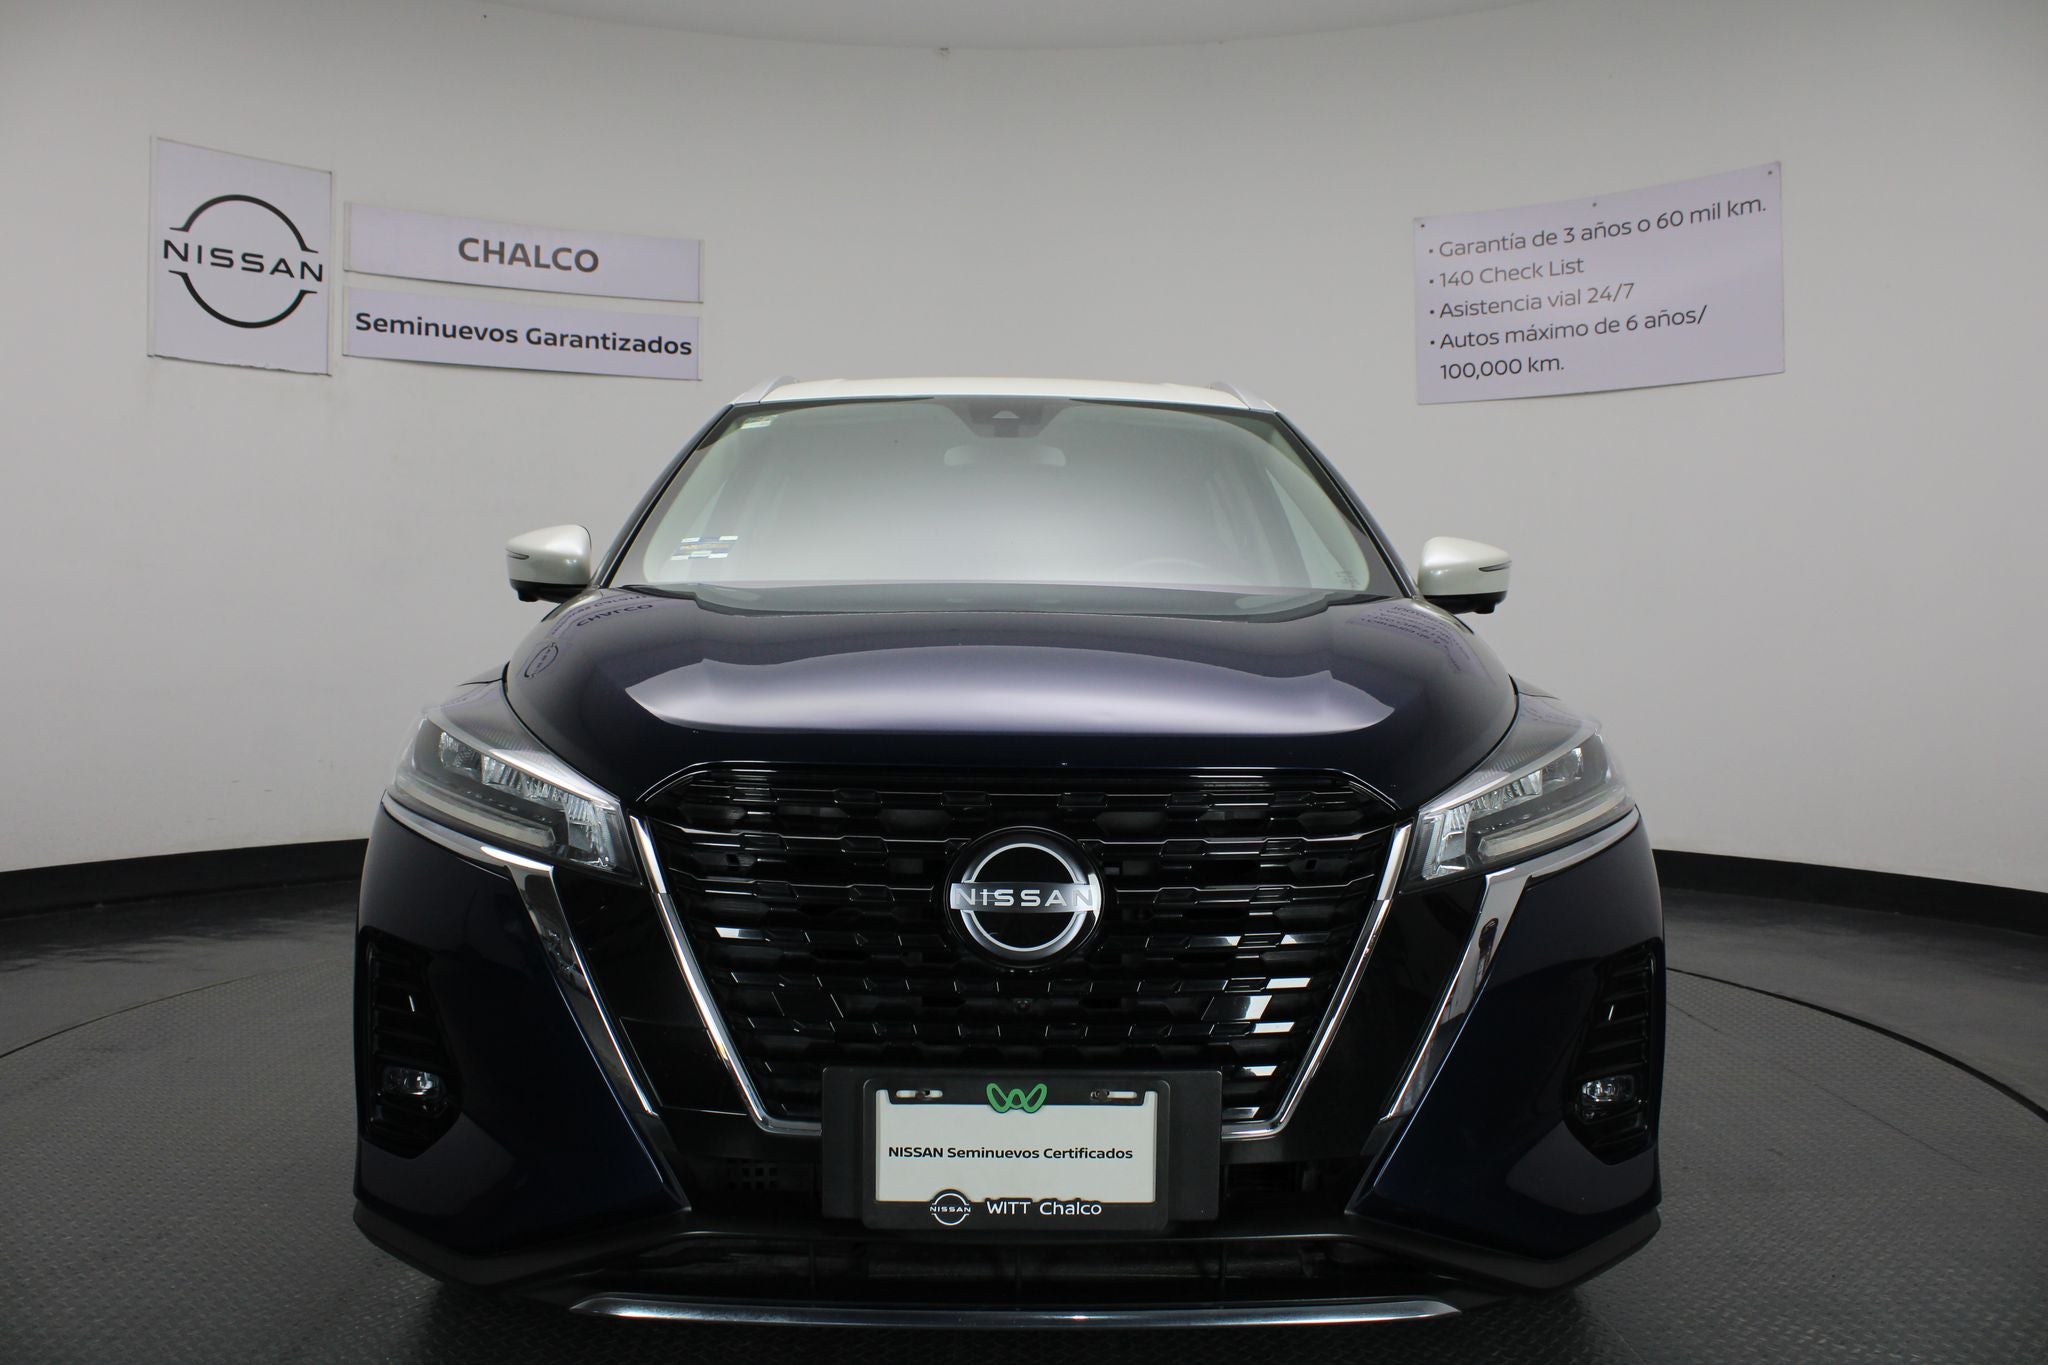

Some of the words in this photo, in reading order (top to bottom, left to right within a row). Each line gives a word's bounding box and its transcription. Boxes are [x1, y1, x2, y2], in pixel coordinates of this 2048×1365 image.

[1439, 232, 1526, 257] Garantía
[1532, 229, 1558, 247] de
[1563, 227, 1575, 244] 3
[1581, 221, 1632, 242] años
[1637, 218, 1651, 233] o
[1656, 210, 1685, 230] 60
[1690, 202, 1721, 225] mil
[1727, 198, 1767, 219] km.
[163, 240, 323, 282] NISSAN
[457, 237, 600, 273] CHALCO
[1439, 269, 1474, 288] 140
[1479, 262, 1544, 285] Check
[1549, 257, 1584, 277] List
[1439, 293, 1543, 319] Asistencia
[1547, 288, 1581, 308] vial
[1587, 282, 1635, 305] 24/7
[355, 311, 519, 344] Seminuevos
[526, 327, 693, 356] Garantizados
[1439, 331, 1500, 350] Autos
[1505, 323, 1589, 345] máximo
[1594, 317, 1621, 335] de
[1626, 314, 1639, 332] 6
[1644, 304, 1707, 330] años/
[1440, 358, 1522, 381] 100,000
[1528, 356, 1565, 374] km.
[956, 887, 1093, 908] NISSAN
[888, 1146, 944, 1159] NISSAN
[947, 1146, 1040, 1159] Seminuevos
[1043, 1147, 1133, 1160] Certificados
[929, 1204, 972, 1214] NISSAN
[986, 1200, 1032, 1215] WITT
[1039, 1199, 1103, 1216] Chalco
